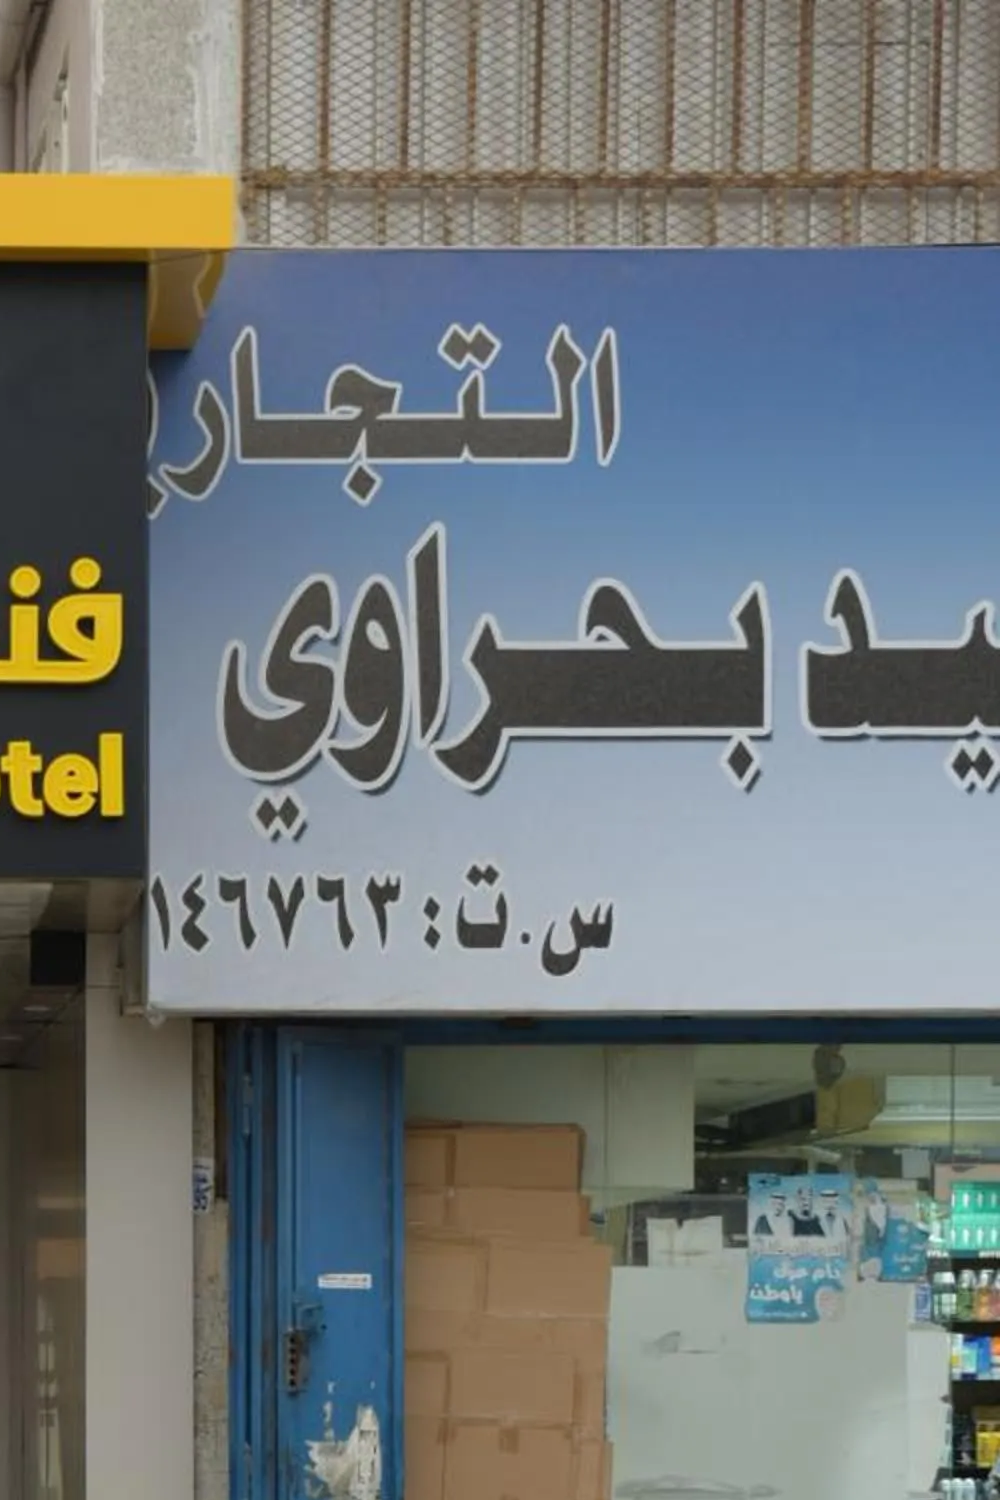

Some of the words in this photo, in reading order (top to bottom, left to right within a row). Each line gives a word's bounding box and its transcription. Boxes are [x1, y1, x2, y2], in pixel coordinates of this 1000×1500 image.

[148, 328, 619, 520] التجار
[219, 524, 769, 840] بحراوي
[150, 874, 402, 952] ١٤٦٧٦٣
